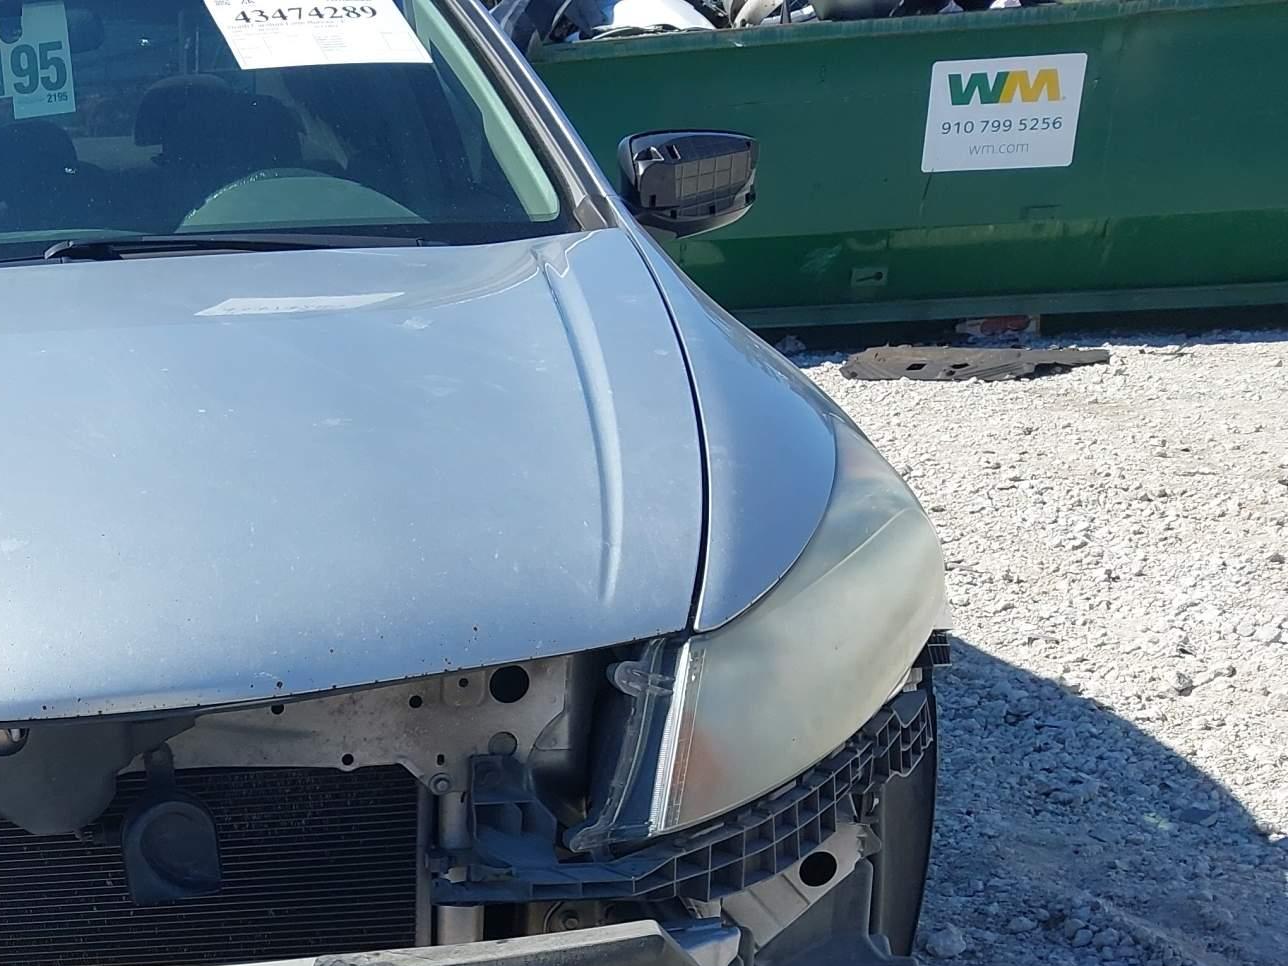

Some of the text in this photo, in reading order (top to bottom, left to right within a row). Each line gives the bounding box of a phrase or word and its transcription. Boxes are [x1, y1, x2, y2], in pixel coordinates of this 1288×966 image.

[234, 5, 378, 23] 43474289
[947, 68, 1061, 106] WM
[47, 92, 68, 104] 2195
[941, 116, 1063, 135] 910 799 5256
[968, 143, 1030, 156] wm.com
